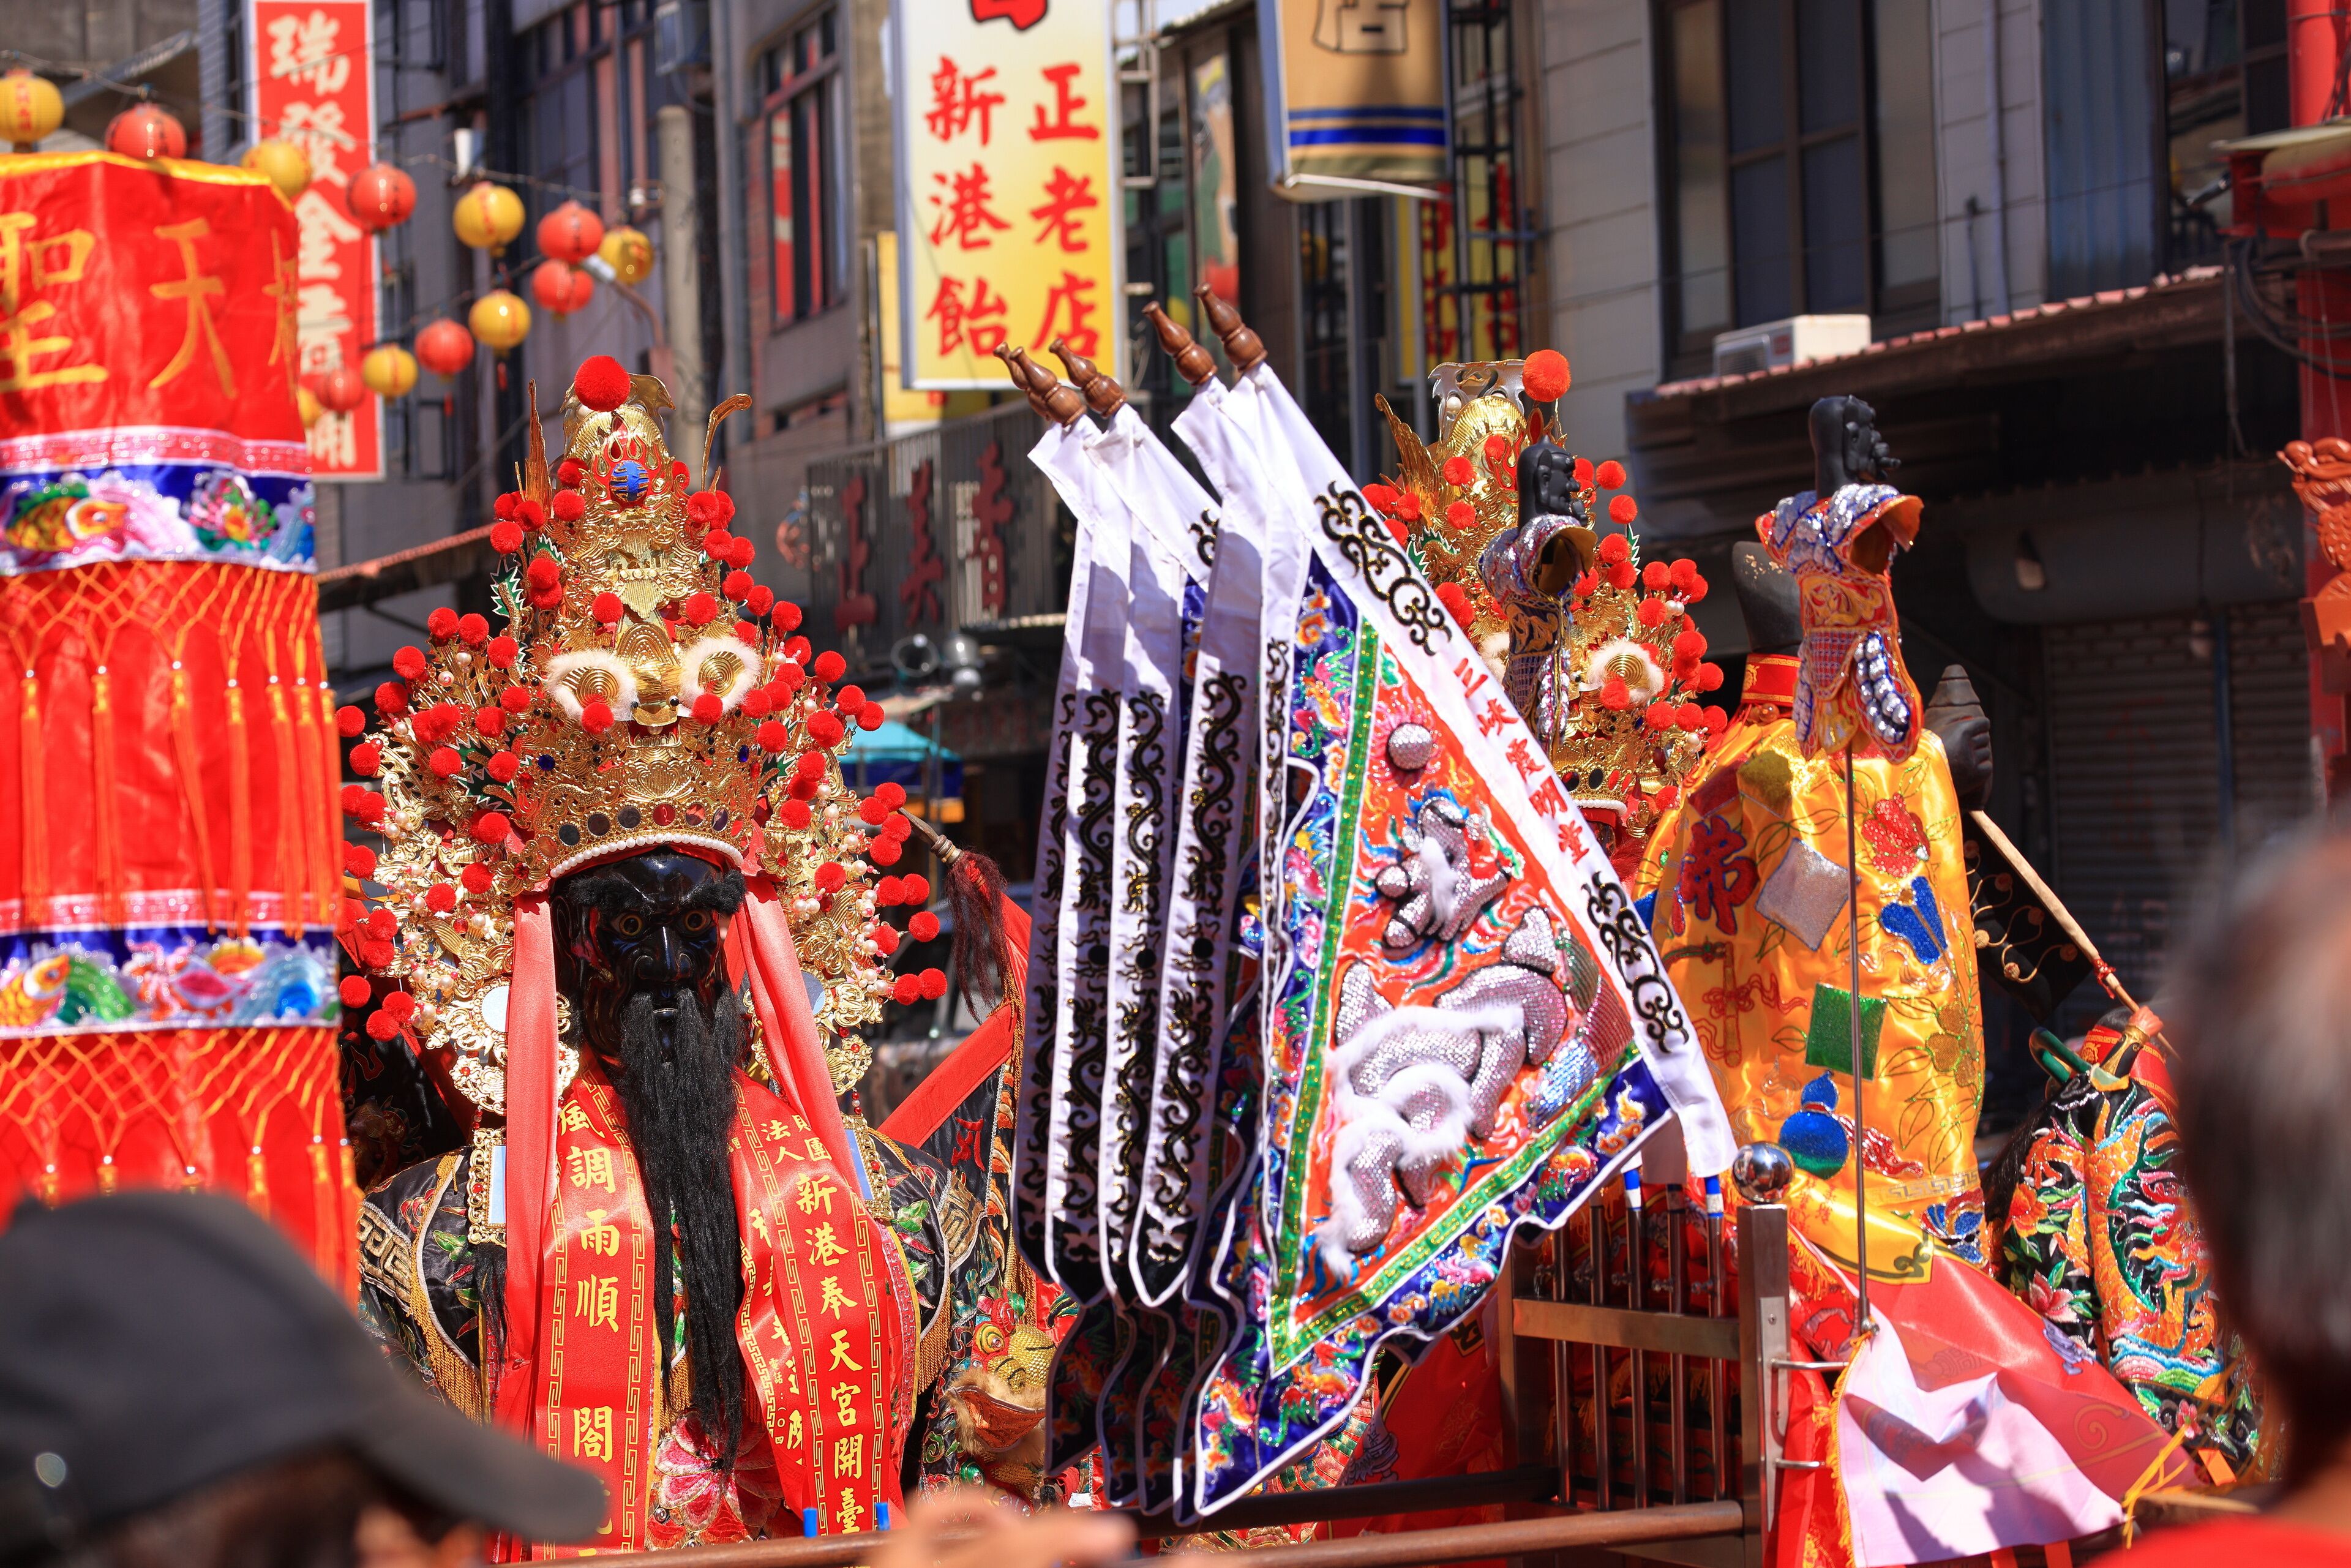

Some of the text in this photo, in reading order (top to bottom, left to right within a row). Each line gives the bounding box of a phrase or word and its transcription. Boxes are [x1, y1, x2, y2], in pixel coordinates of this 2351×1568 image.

[923, 55, 1011, 357] 新港飴
[1028, 61, 1100, 359] 正老店
